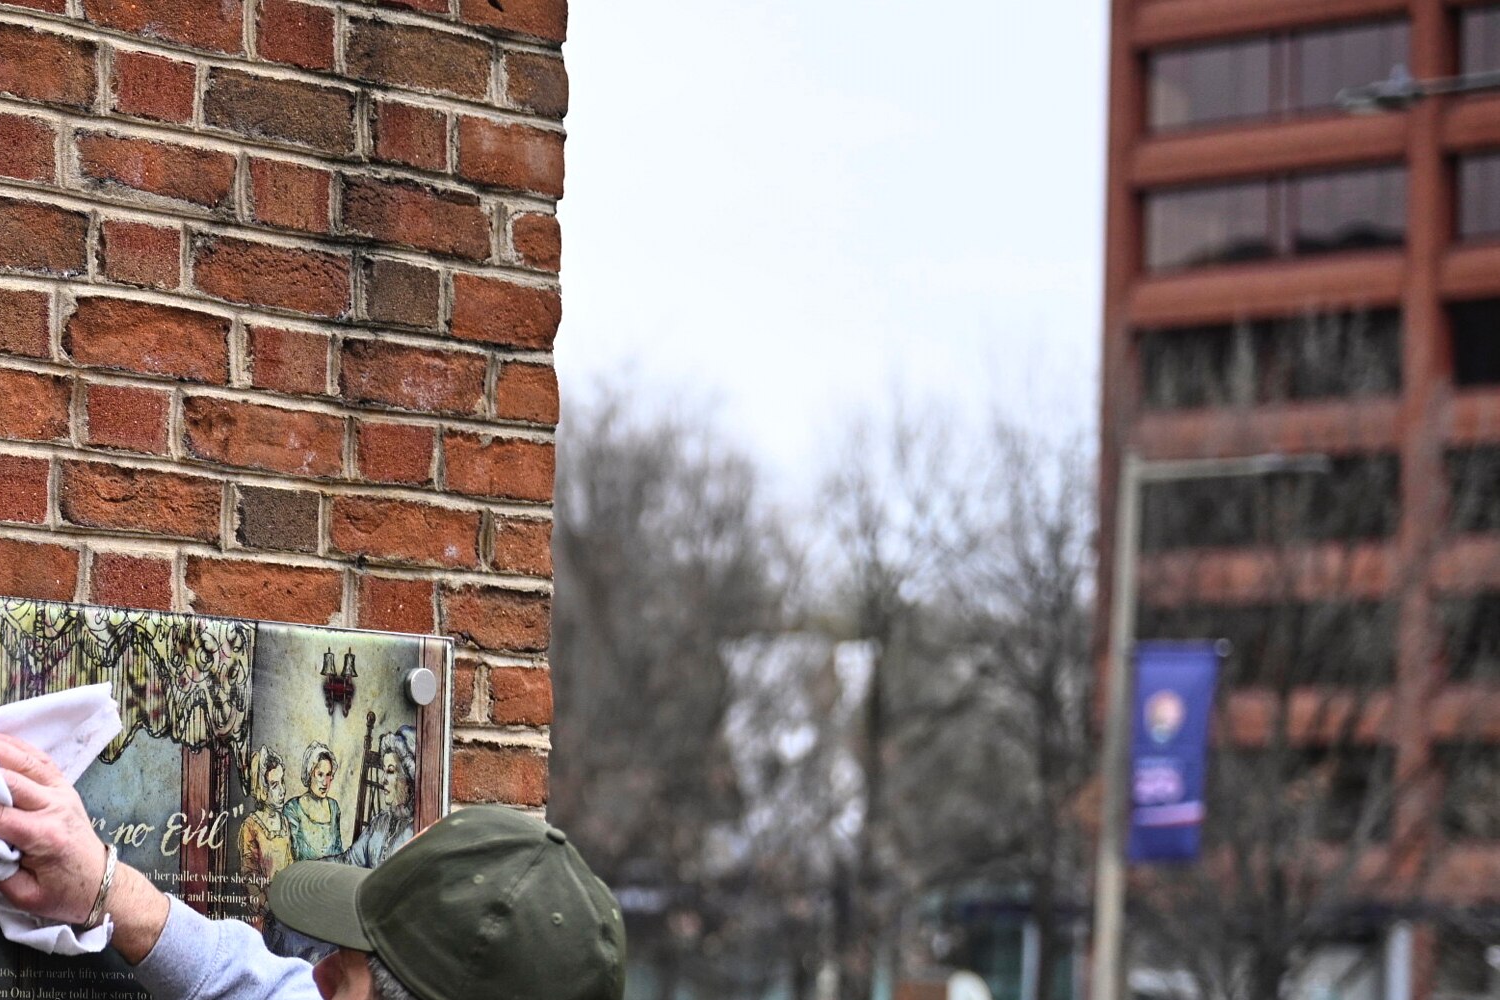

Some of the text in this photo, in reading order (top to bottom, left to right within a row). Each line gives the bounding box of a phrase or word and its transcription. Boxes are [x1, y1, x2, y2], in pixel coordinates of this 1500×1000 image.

[109, 822, 155, 848] no
[154, 869, 171, 880] her
[172, 871, 198, 885] pallet
[201, 872, 229, 883] where
[231, 872, 247, 884] she
[249, 873, 270, 888] slept
[187, 890, 205, 902] and
[208, 891, 247, 907] listening
[250, 895, 260, 904] to
[19, 966, 44, 978] after
[10, 986, 35, 1000] Ona)
[68, 988, 90, 1000] told
[91, 989, 109, 1000] her
[136, 991, 147, 1000] to
